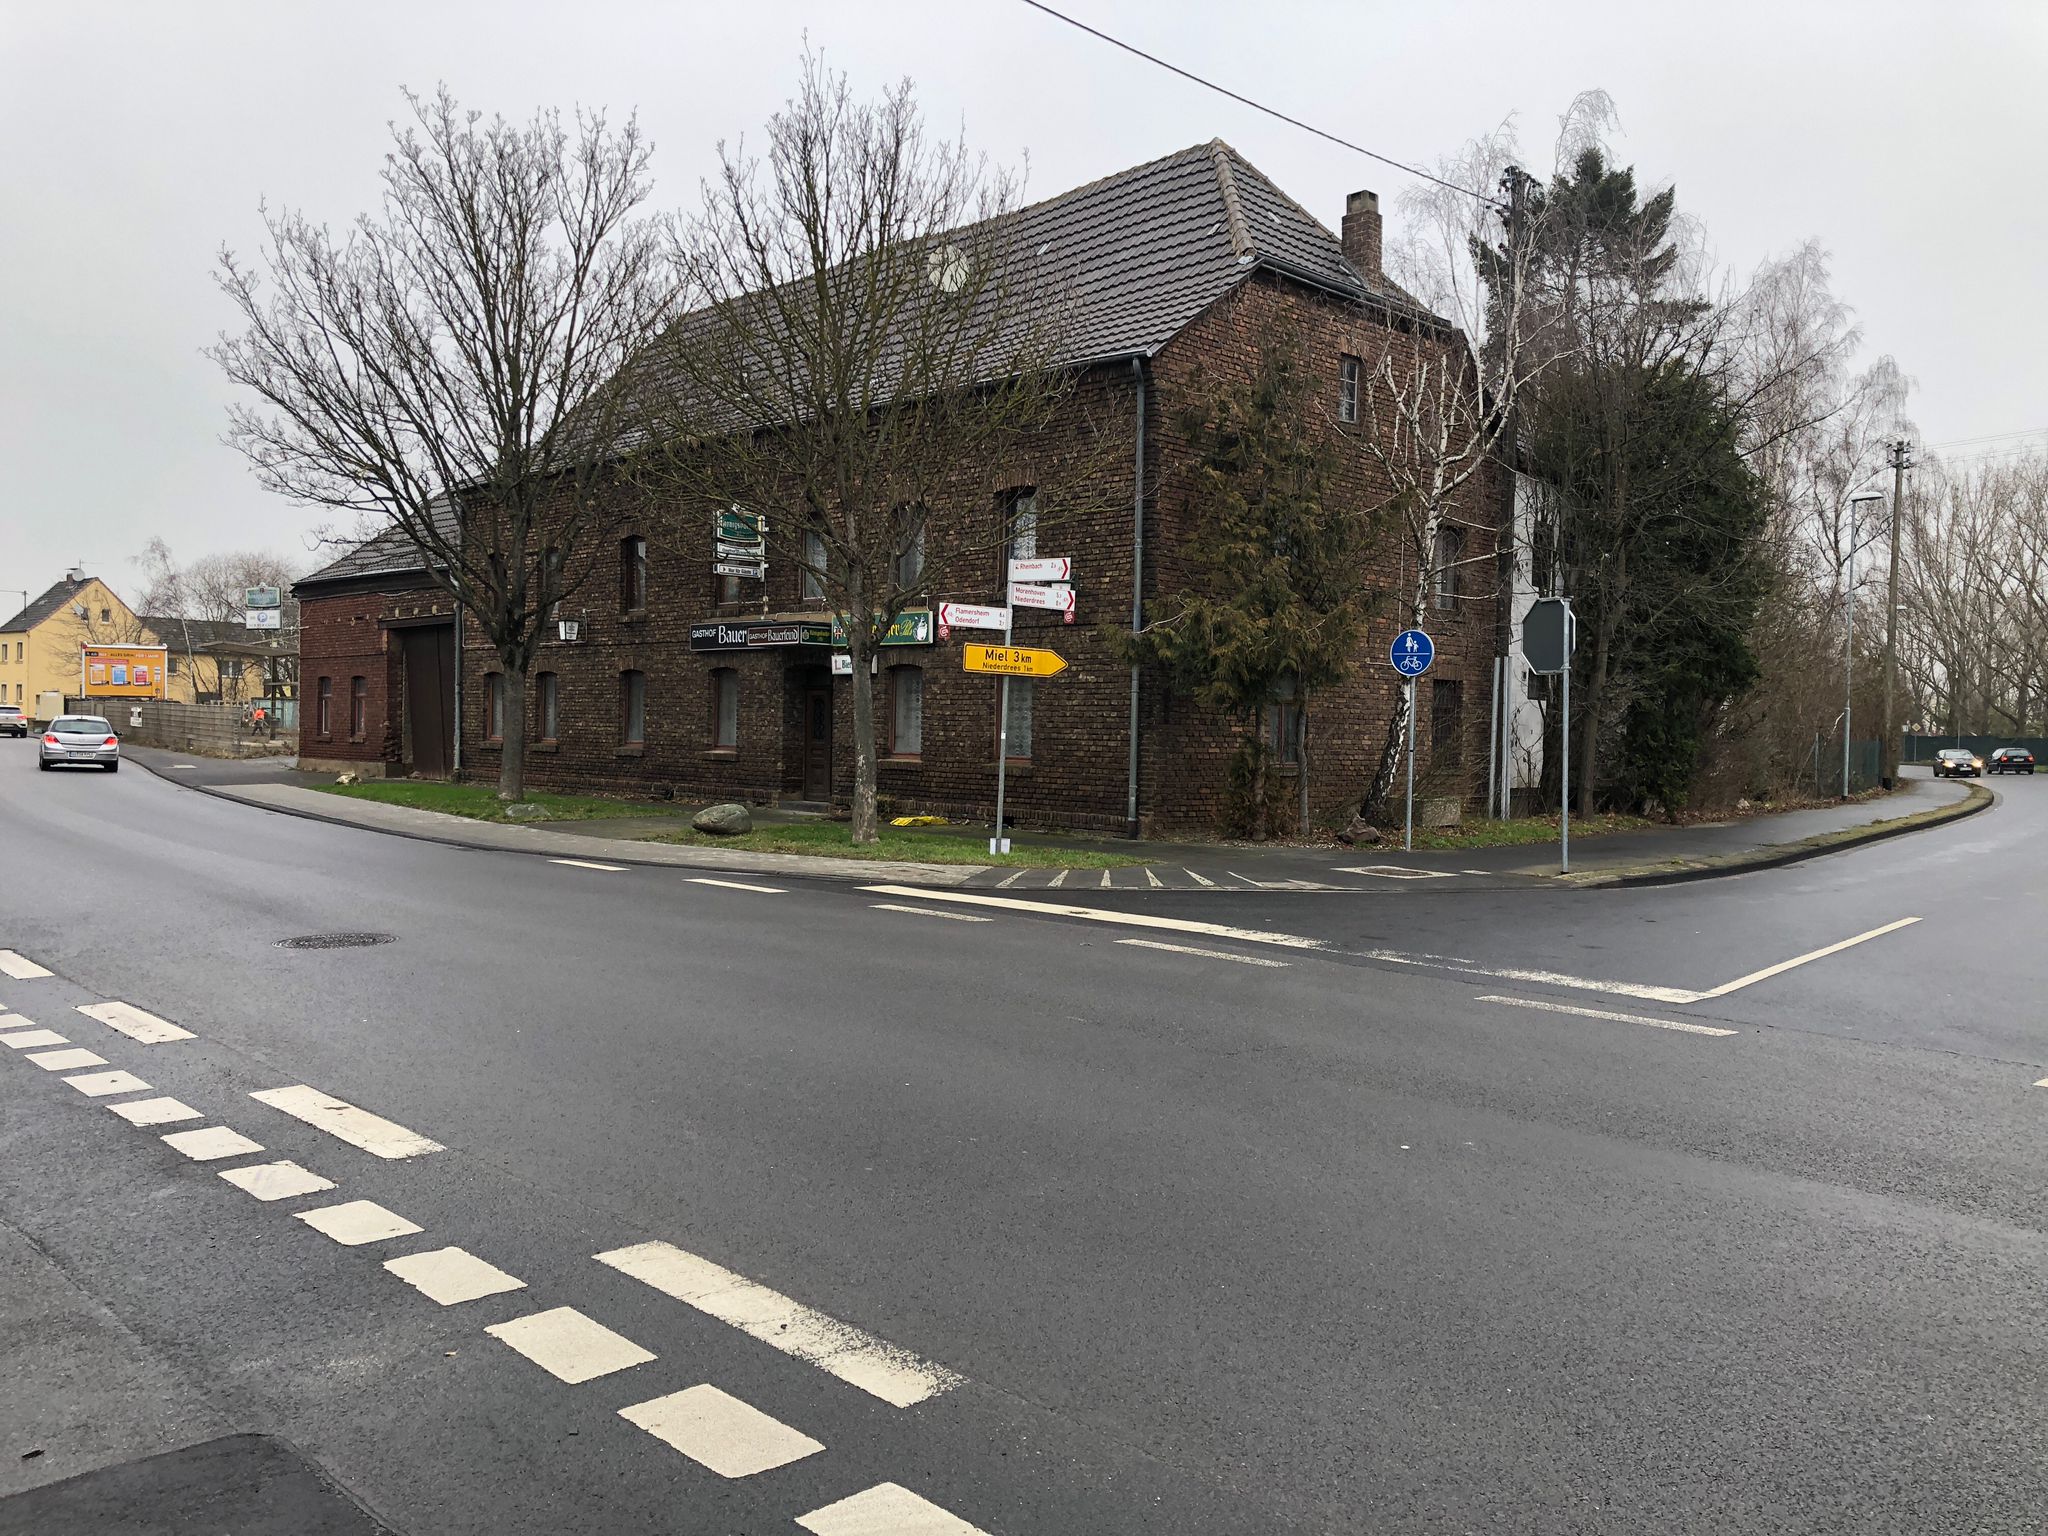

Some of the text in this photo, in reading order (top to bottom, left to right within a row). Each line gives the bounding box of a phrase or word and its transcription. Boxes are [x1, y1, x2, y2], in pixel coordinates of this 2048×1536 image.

[1020, 562, 1043, 570] Rheinbach
[1015, 586, 1046, 596] Morenhoven
[1014, 596, 1046, 605] Niederdrees
[955, 607, 990, 617] Flamersheim
[955, 616, 980, 625] Odendorf
[691, 628, 717, 639] GASTHOF
[749, 632, 768, 640] GASTHOF
[985, 648, 1032, 664] Miel 3 km
[982, 661, 1021, 672] Niederdrees
